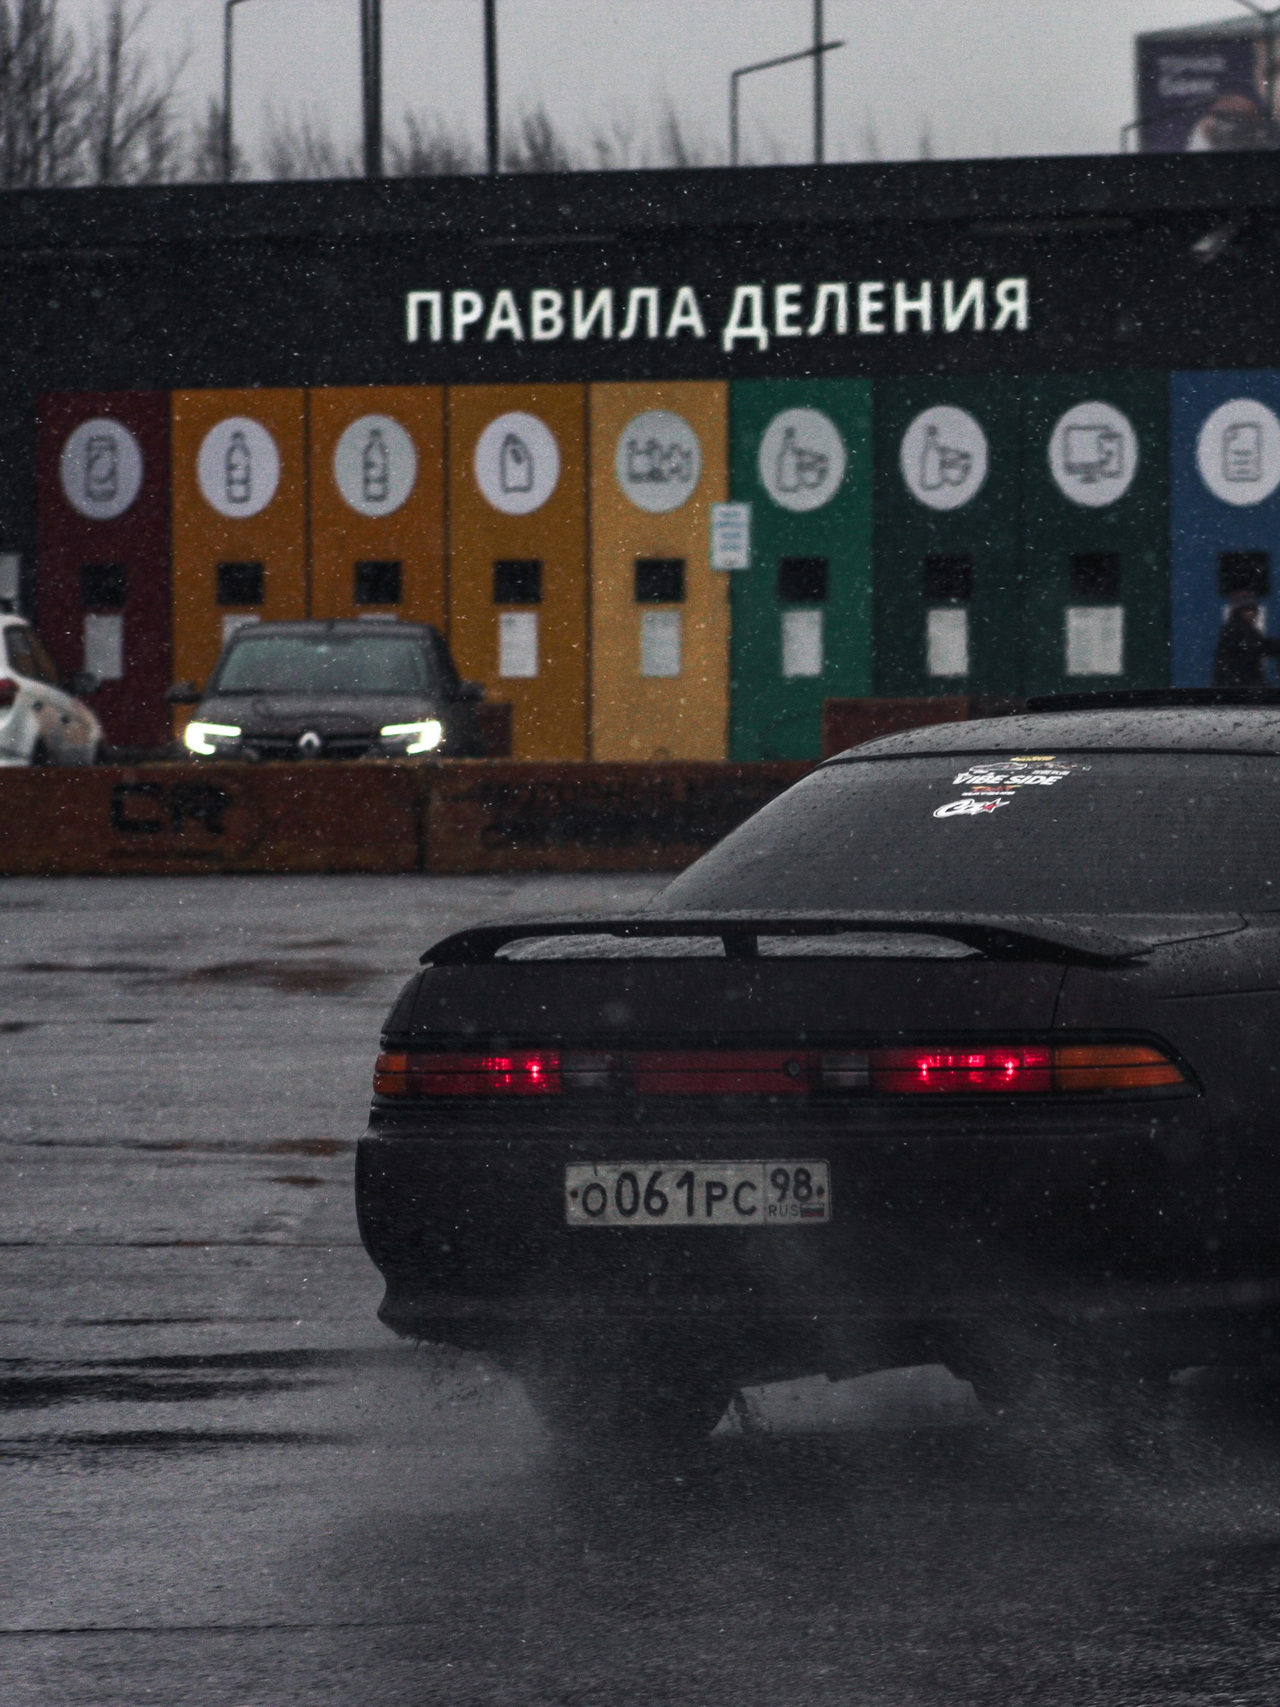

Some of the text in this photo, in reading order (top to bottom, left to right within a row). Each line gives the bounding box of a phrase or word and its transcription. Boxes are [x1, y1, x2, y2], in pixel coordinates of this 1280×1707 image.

[406, 278, 1029, 353] ПРАВИЛА ДЕЛЕНИЯ
[1004, 774, 1064, 786] SIDE
[770, 1167, 813, 1201] 98
[768, 1203, 799, 1217] RUS
